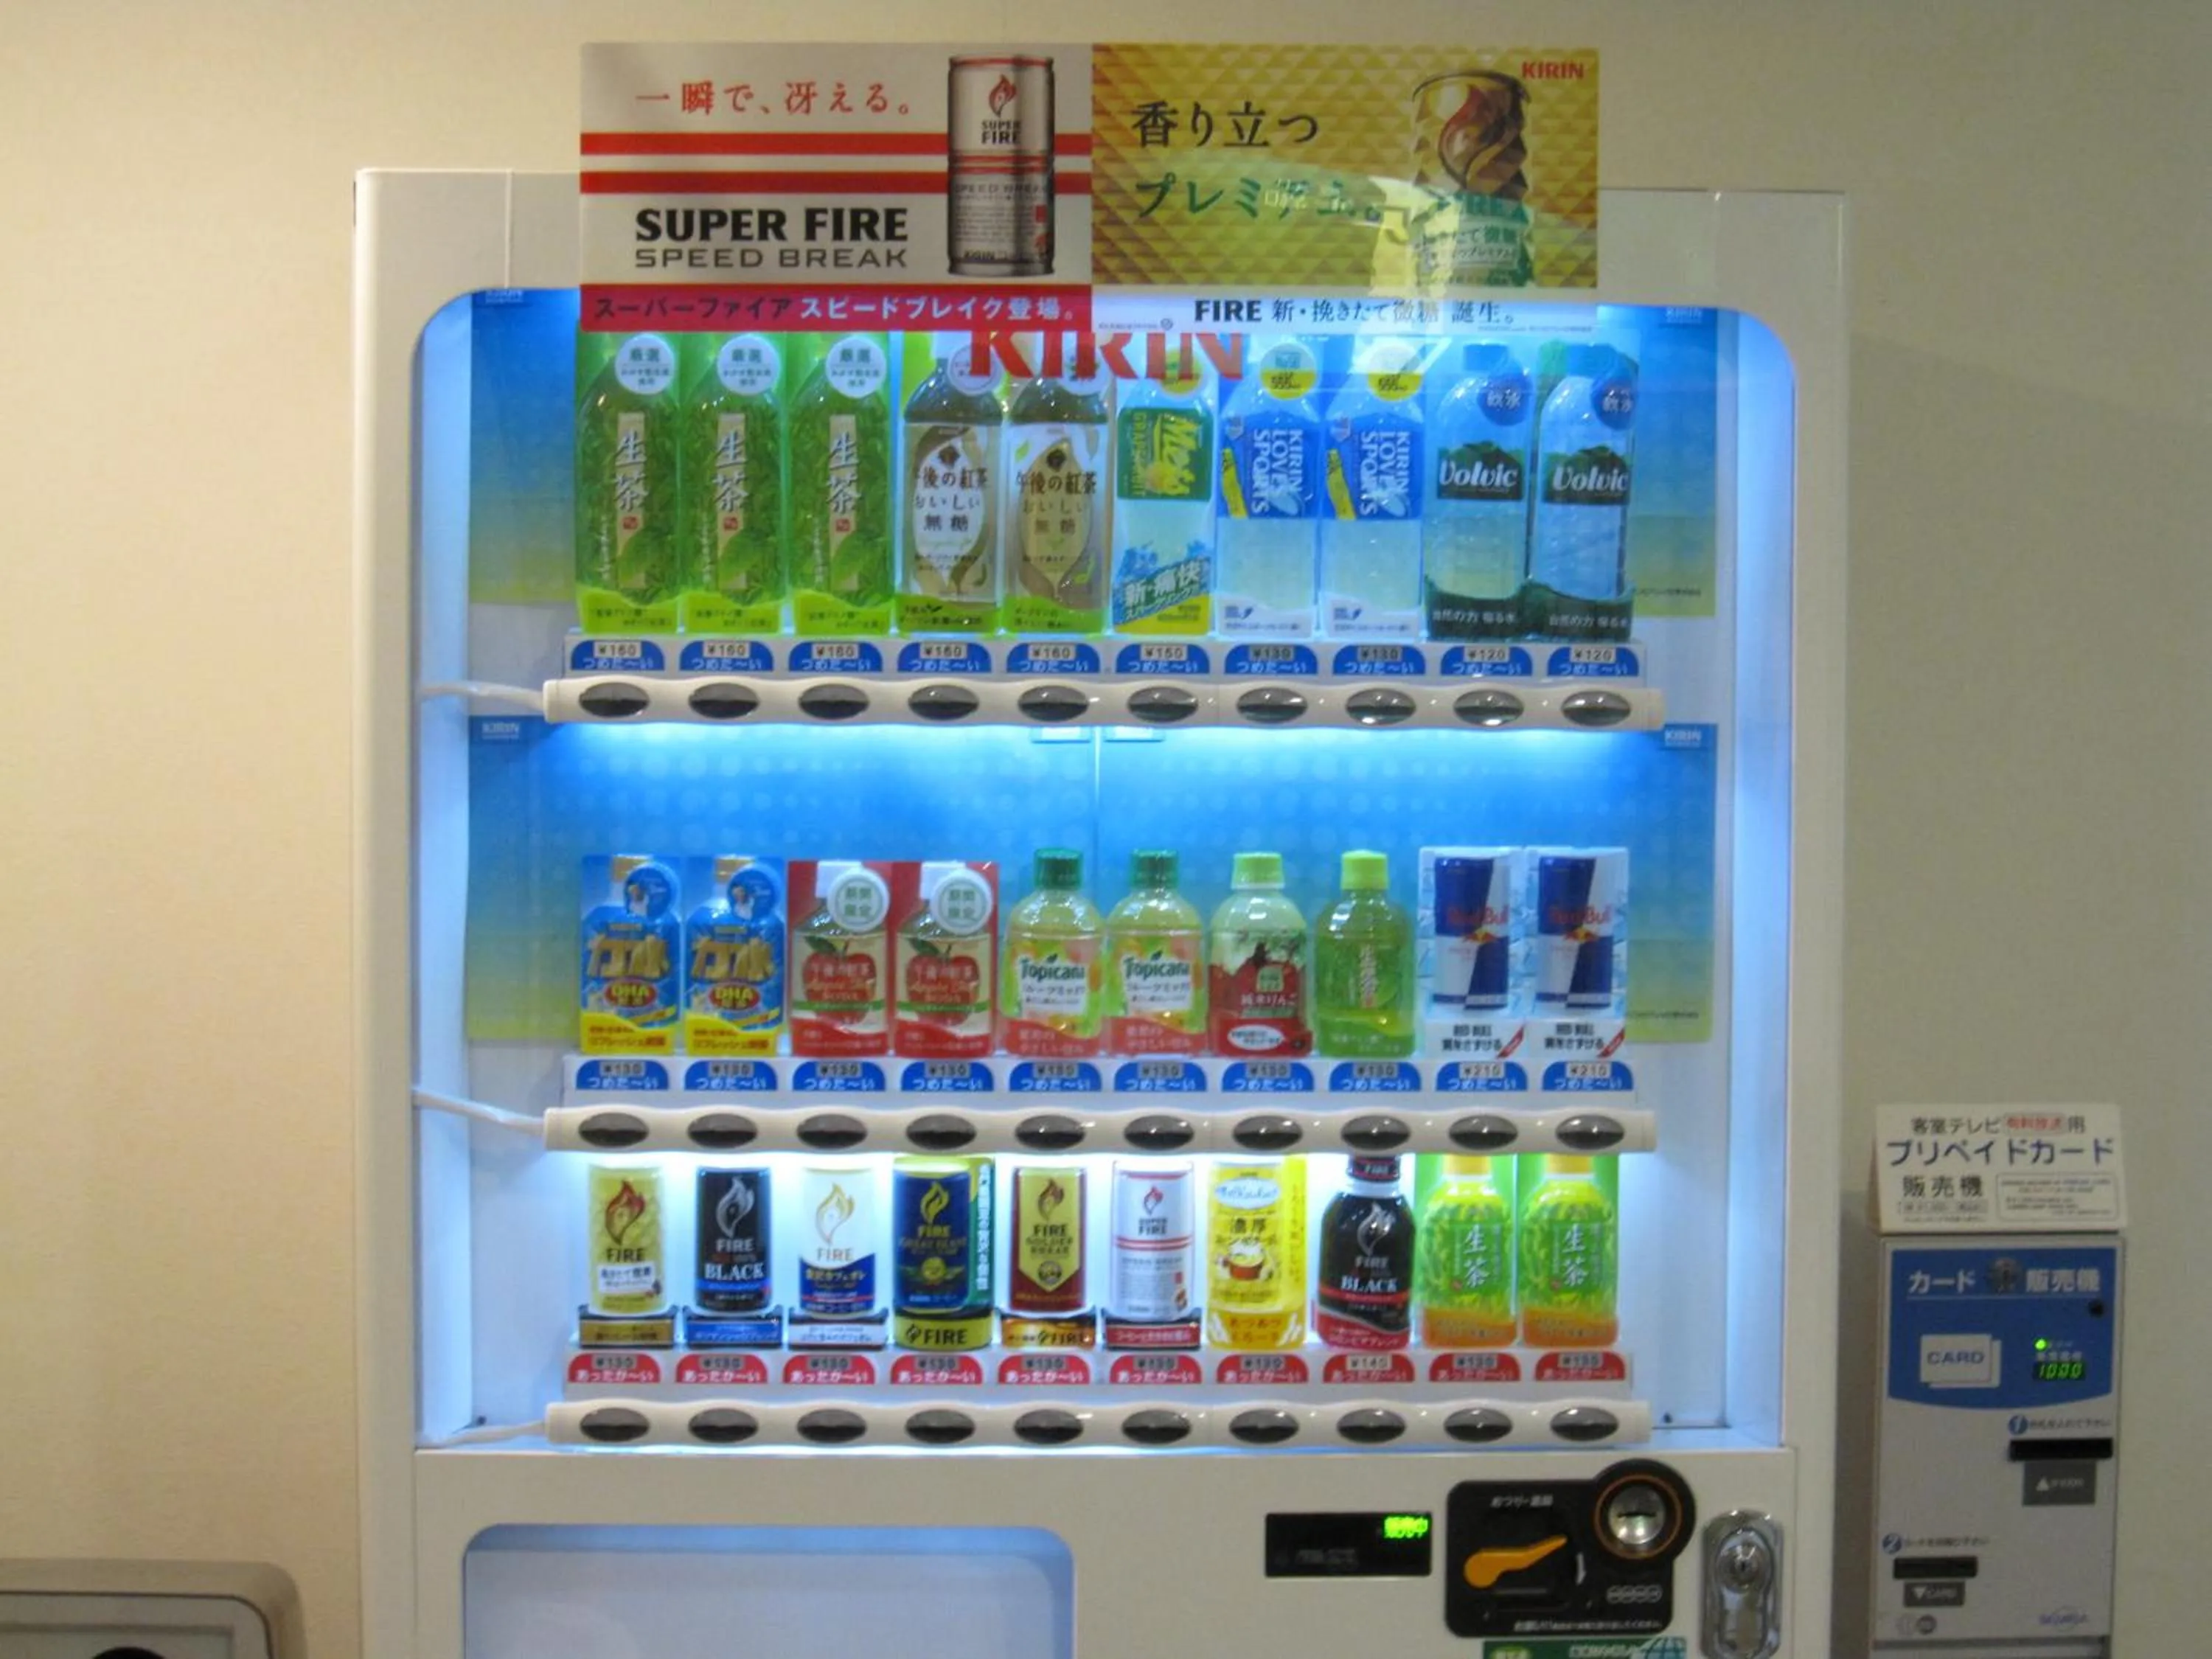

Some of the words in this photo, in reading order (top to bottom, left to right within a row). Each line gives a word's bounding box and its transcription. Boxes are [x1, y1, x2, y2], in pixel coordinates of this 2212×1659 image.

[1522, 61, 1584, 80] KIRIN
[635, 80, 911, 116] 一瞬で、冴える。
[1130, 101, 1320, 147] 香り立つ
[981, 130, 1022, 145] FIRE
[636, 207, 787, 243] SUPER
[804, 207, 908, 242] FIRE
[634, 248, 764, 268] SPEED
[779, 248, 908, 268] BREAK
[594, 296, 793, 319] スーパーファイア
[800, 296, 1077, 321] スピードブレイク登場。
[1194, 299, 1262, 323] FIRE
[1450, 297, 1514, 324] 誕生。
[1288, 429, 1304, 491] KIRIN
[1378, 431, 1395, 495] LOVE
[1396, 431, 1410, 493] KIRIN
[613, 432, 649, 514] 生茶
[712, 432, 749, 514] 生茶
[826, 434, 861, 515] 生茶
[1439, 461, 1520, 488] Volvic
[1552, 465, 1629, 493] Volvic
[923, 515, 969, 532] 無糖
[1468, 648, 1506, 661] ¥120
[1573, 648, 1613, 661] ¥120
[1464, 1064, 1500, 1076] ¥210
[1571, 1063, 1607, 1076] ¥210
[1902, 1174, 1983, 1198] 販売機
[1033, 1224, 1068, 1237] FIRE
[606, 1248, 645, 1262] FIRE
[716, 1239, 754, 1252] FIRE
[816, 1248, 855, 1262] FIRE
[1464, 1223, 1489, 1288] 生茶
[1562, 1222, 1588, 1287] 生茶
[705, 1262, 765, 1280] BLACK
[1354, 1256, 1389, 1268] FIRE
[1340, 1276, 1397, 1292] BLACK
[1907, 1268, 1977, 1294] カード
[923, 1329, 968, 1345] FIRE
[1926, 1351, 1986, 1365] CARD
[2039, 1362, 2083, 1380] 1000
